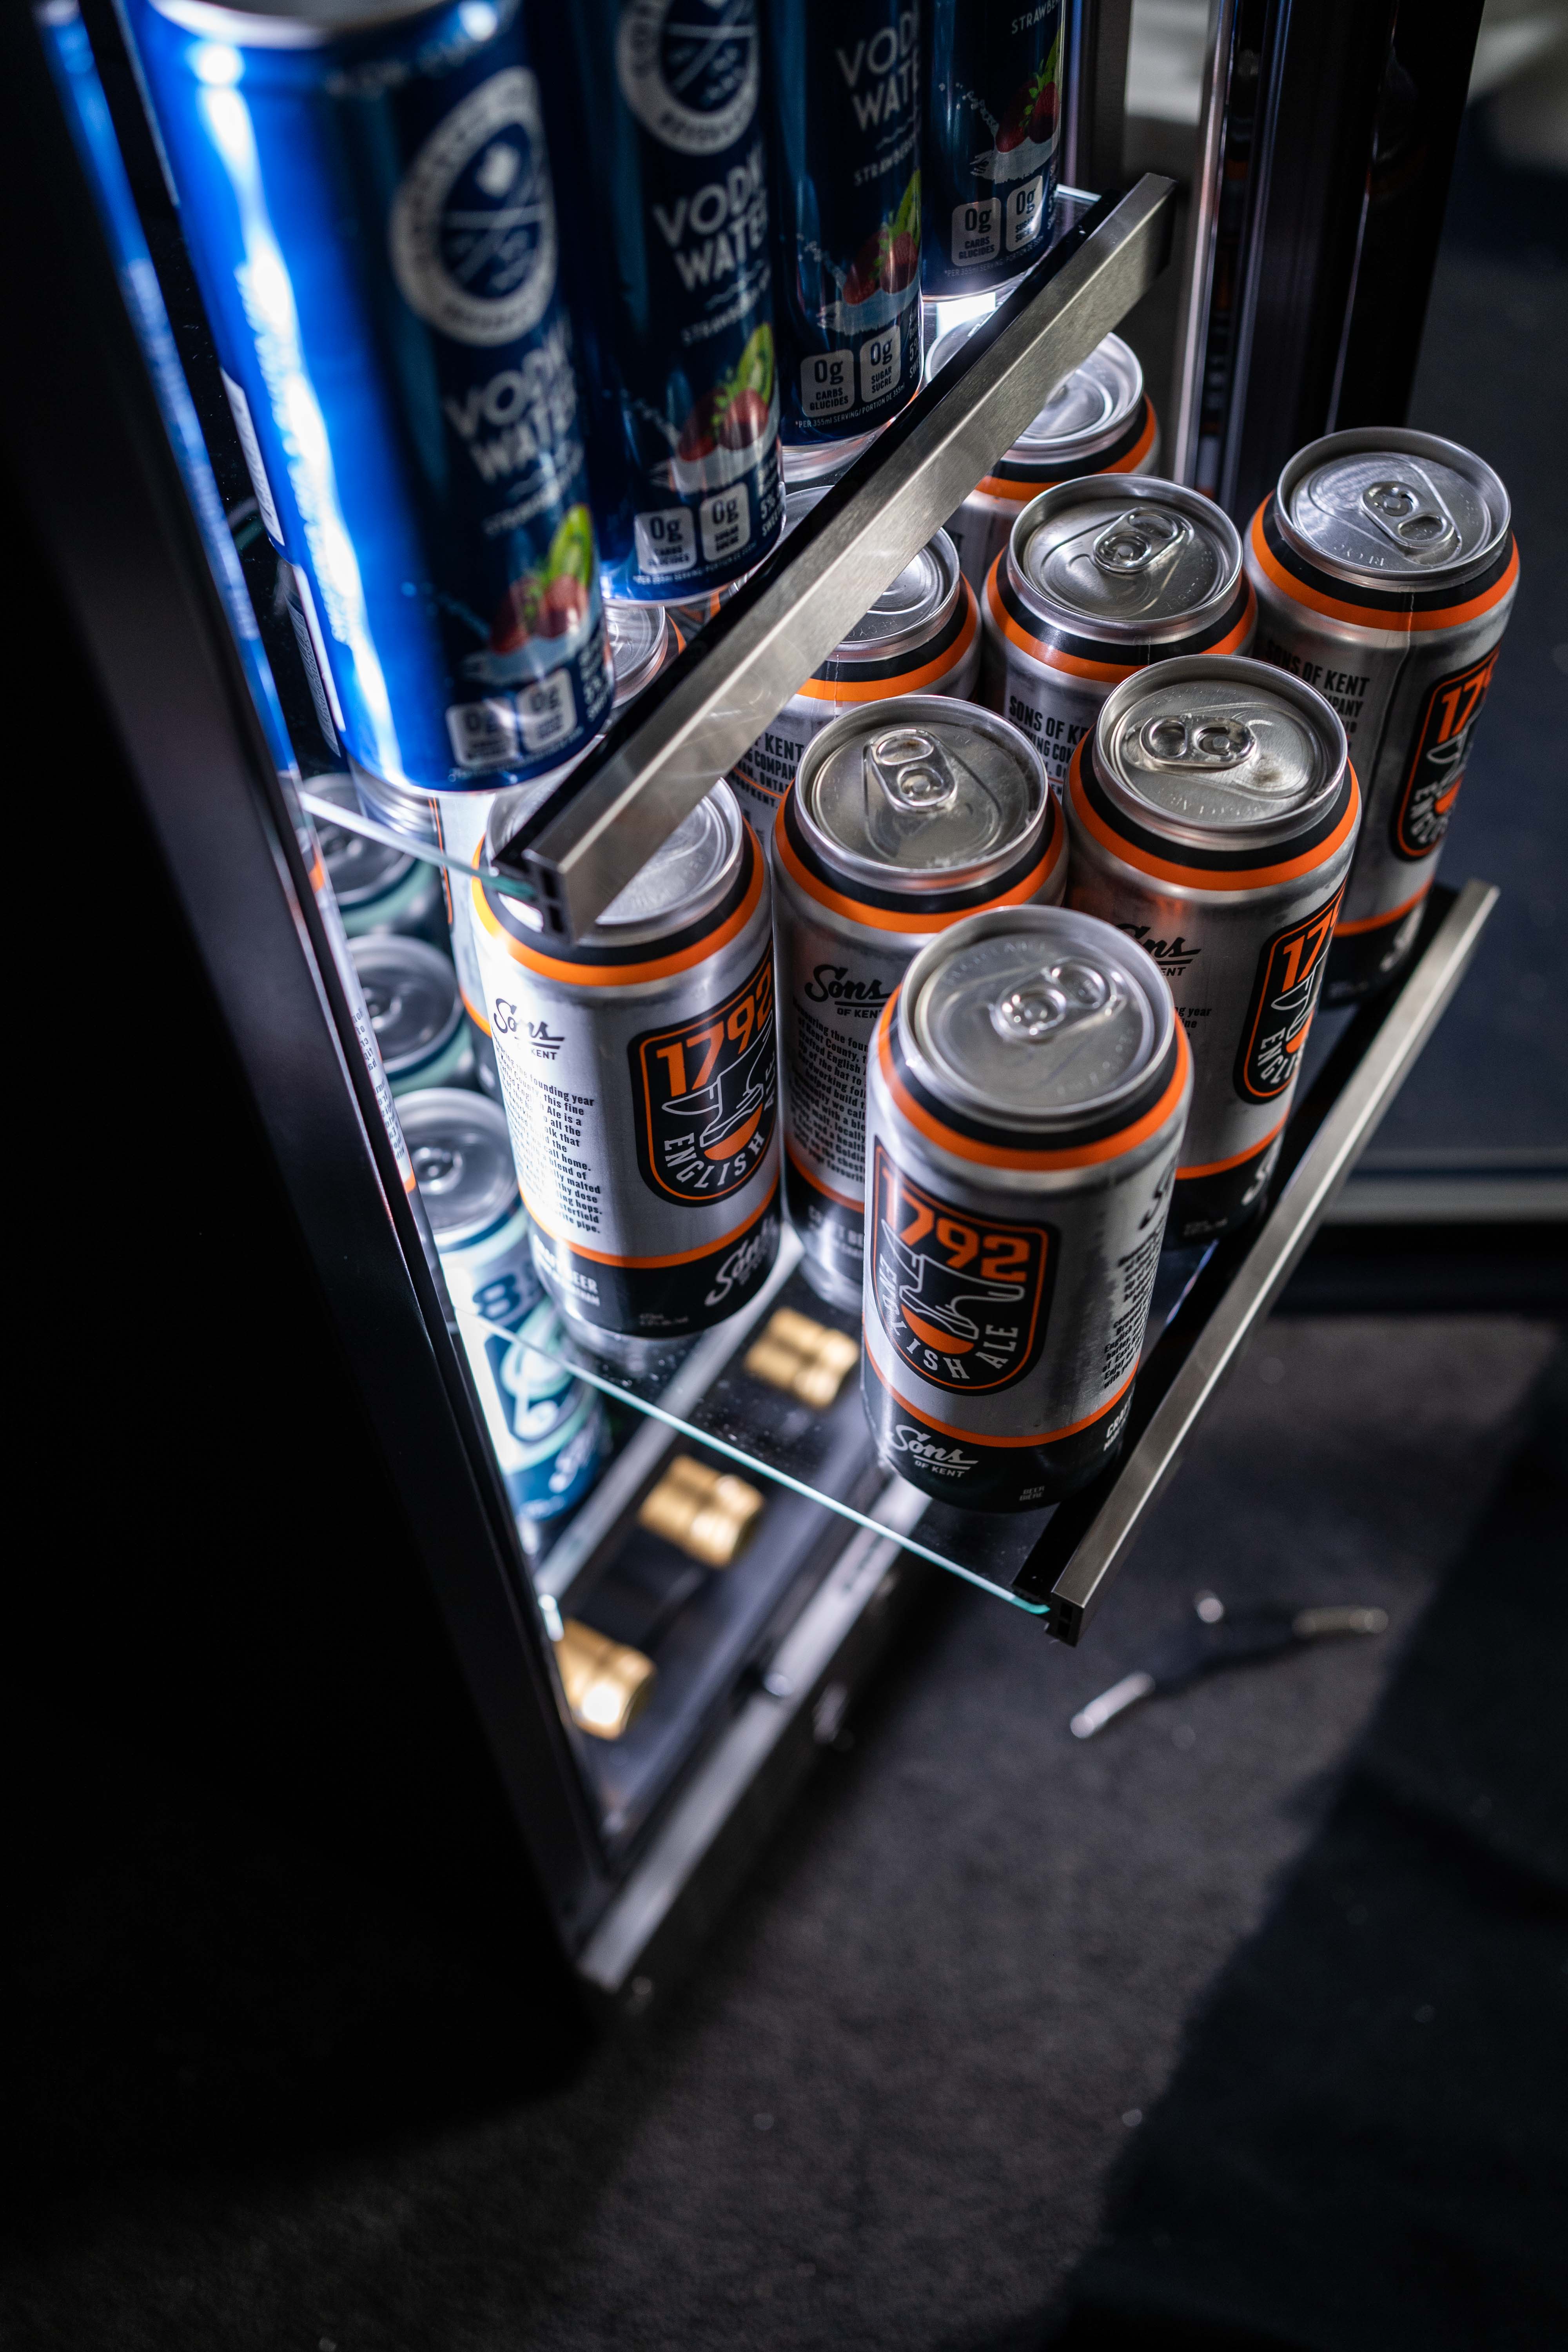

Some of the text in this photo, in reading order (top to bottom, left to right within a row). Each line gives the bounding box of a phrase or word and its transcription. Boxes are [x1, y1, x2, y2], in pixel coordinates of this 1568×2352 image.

[837, 10, 918, 87] VOD
[851, 45, 918, 131] WAT
[965, 189, 1036, 233] 0g 0g
[964, 236, 990, 249] CARBS
[814, 338, 893, 385] 0g 0g
[871, 366, 892, 385] SUGAR
[871, 376, 892, 394] SUCRE
[809, 396, 849, 412] GLUCIDES
[815, 387, 843, 401] CARBS
[650, 515, 682, 543] 0g
[713, 498, 738, 526] 0g
[1303, 662, 1323, 684] OF
[1324, 669, 1370, 697] KENT
[1009, 695, 1043, 732] SONS
[1046, 715, 1065, 740] OF
[764, 732, 804, 762] KENT
[754, 751, 798, 781] COMPAN
[1161, 966, 1186, 976] ENT
[804, 964, 892, 1002] Sons
[837, 1007, 882, 1019] OF KEN
[1187, 1008, 1212, 1018] year
[656, 962, 773, 1098] 1792
[806, 1023, 823, 1044] Kent
[831, 1030, 845, 1044] the
[531, 1049, 557, 1060] KENT
[827, 1050, 861, 1074] English
[809, 1051, 818, 1062] of
[819, 1058, 833, 1073] the
[834, 1067, 850, 1081] hat
[852, 1075, 862, 1086] to
[530, 1074, 570, 1102] founding
[571, 1094, 595, 1107] year
[834, 1089, 858, 1107] build
[850, 1085, 866, 1098] fol
[544, 1094, 561, 1109] this
[564, 1102, 584, 1116] fine
[547, 1105, 561, 1119] Ale
[564, 1112, 573, 1123] is
[832, 1100, 844, 1112] we
[847, 1108, 865, 1120] call
[822, 1104, 840, 1121] with
[851, 1118, 865, 1131] ble
[550, 1120, 562, 1130] all
[564, 1125, 581, 1137] the
[552, 1140, 567, 1152] the
[560, 1133, 580, 1147] that
[837, 1133, 865, 1153] health
[544, 1145, 559, 1159] call
[561, 1153, 592, 1171] home.
[664, 1130, 766, 1189] ENGLISH
[835, 1144, 865, 1163] Goldin
[549, 1156, 574, 1176] blend
[576, 1171, 587, 1180] of
[827, 1160, 865, 1183] favourit
[567, 1177, 601, 1194] malted
[574, 1190, 598, 1203] dose
[575, 1199, 603, 1215] hops.
[577, 1220, 601, 1234] pipe.
[881, 1165, 1030, 1282] 1792
[572, 1270, 599, 1294] EER
[879, 1253, 1019, 1380] ENGLISH ALE
[1102, 1343, 1131, 1373] of East
[1104, 1357, 1125, 1381] Enjoy
[1104, 1370, 1120, 1389] with
[889, 1424, 979, 1465] Sons
[915, 1460, 965, 1478] OF KENT
